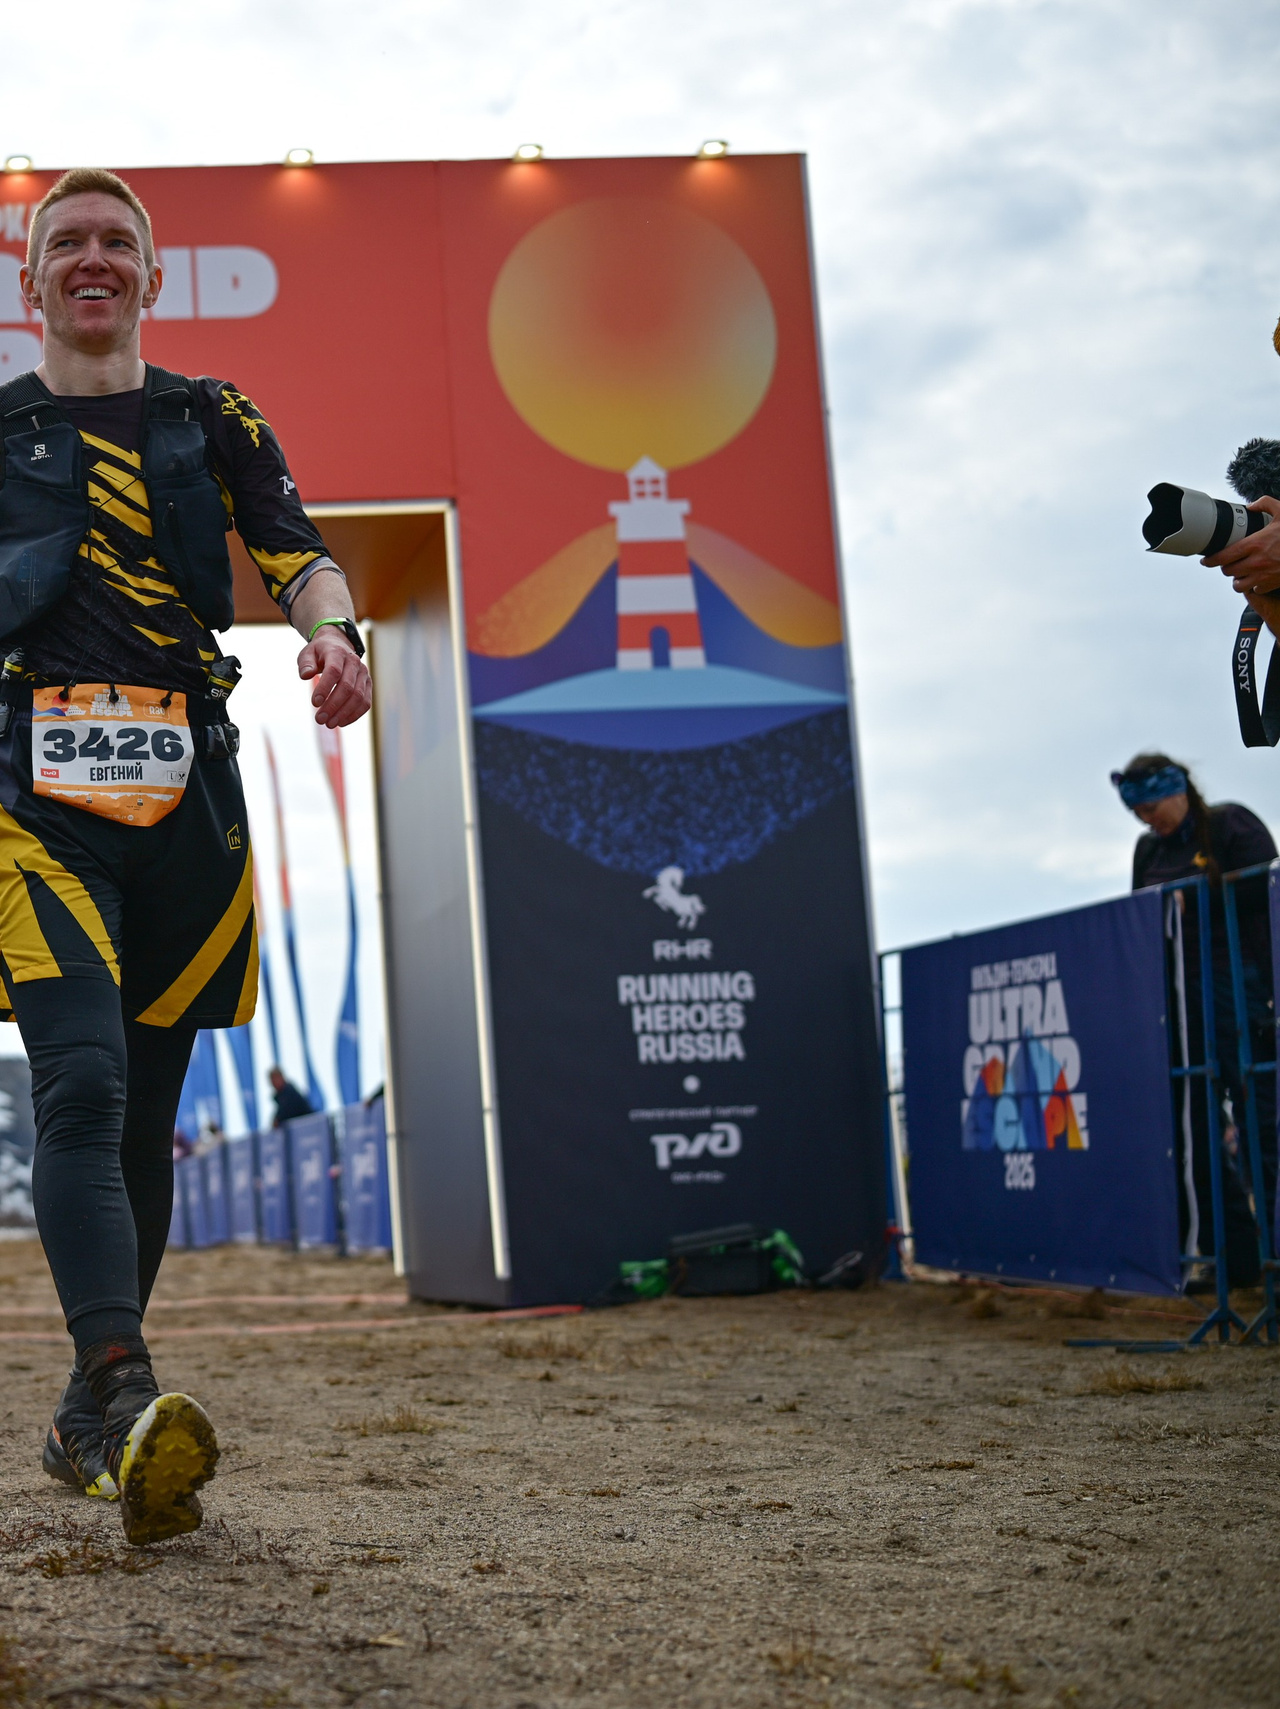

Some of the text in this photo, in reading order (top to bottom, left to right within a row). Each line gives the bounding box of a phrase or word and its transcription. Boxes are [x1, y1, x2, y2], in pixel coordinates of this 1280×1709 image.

[1238, 637, 1251, 694] SONY
[43, 727, 185, 763] 3426
[90, 762, 143, 781] ЕВГЕНИЙ
[653, 939, 713, 961] RHR
[618, 971, 755, 1004] RUNNING
[632, 1002, 745, 1034] HEROES
[968, 979, 1069, 1045] ULTRA
[638, 1032, 745, 1064] RUSSIA
